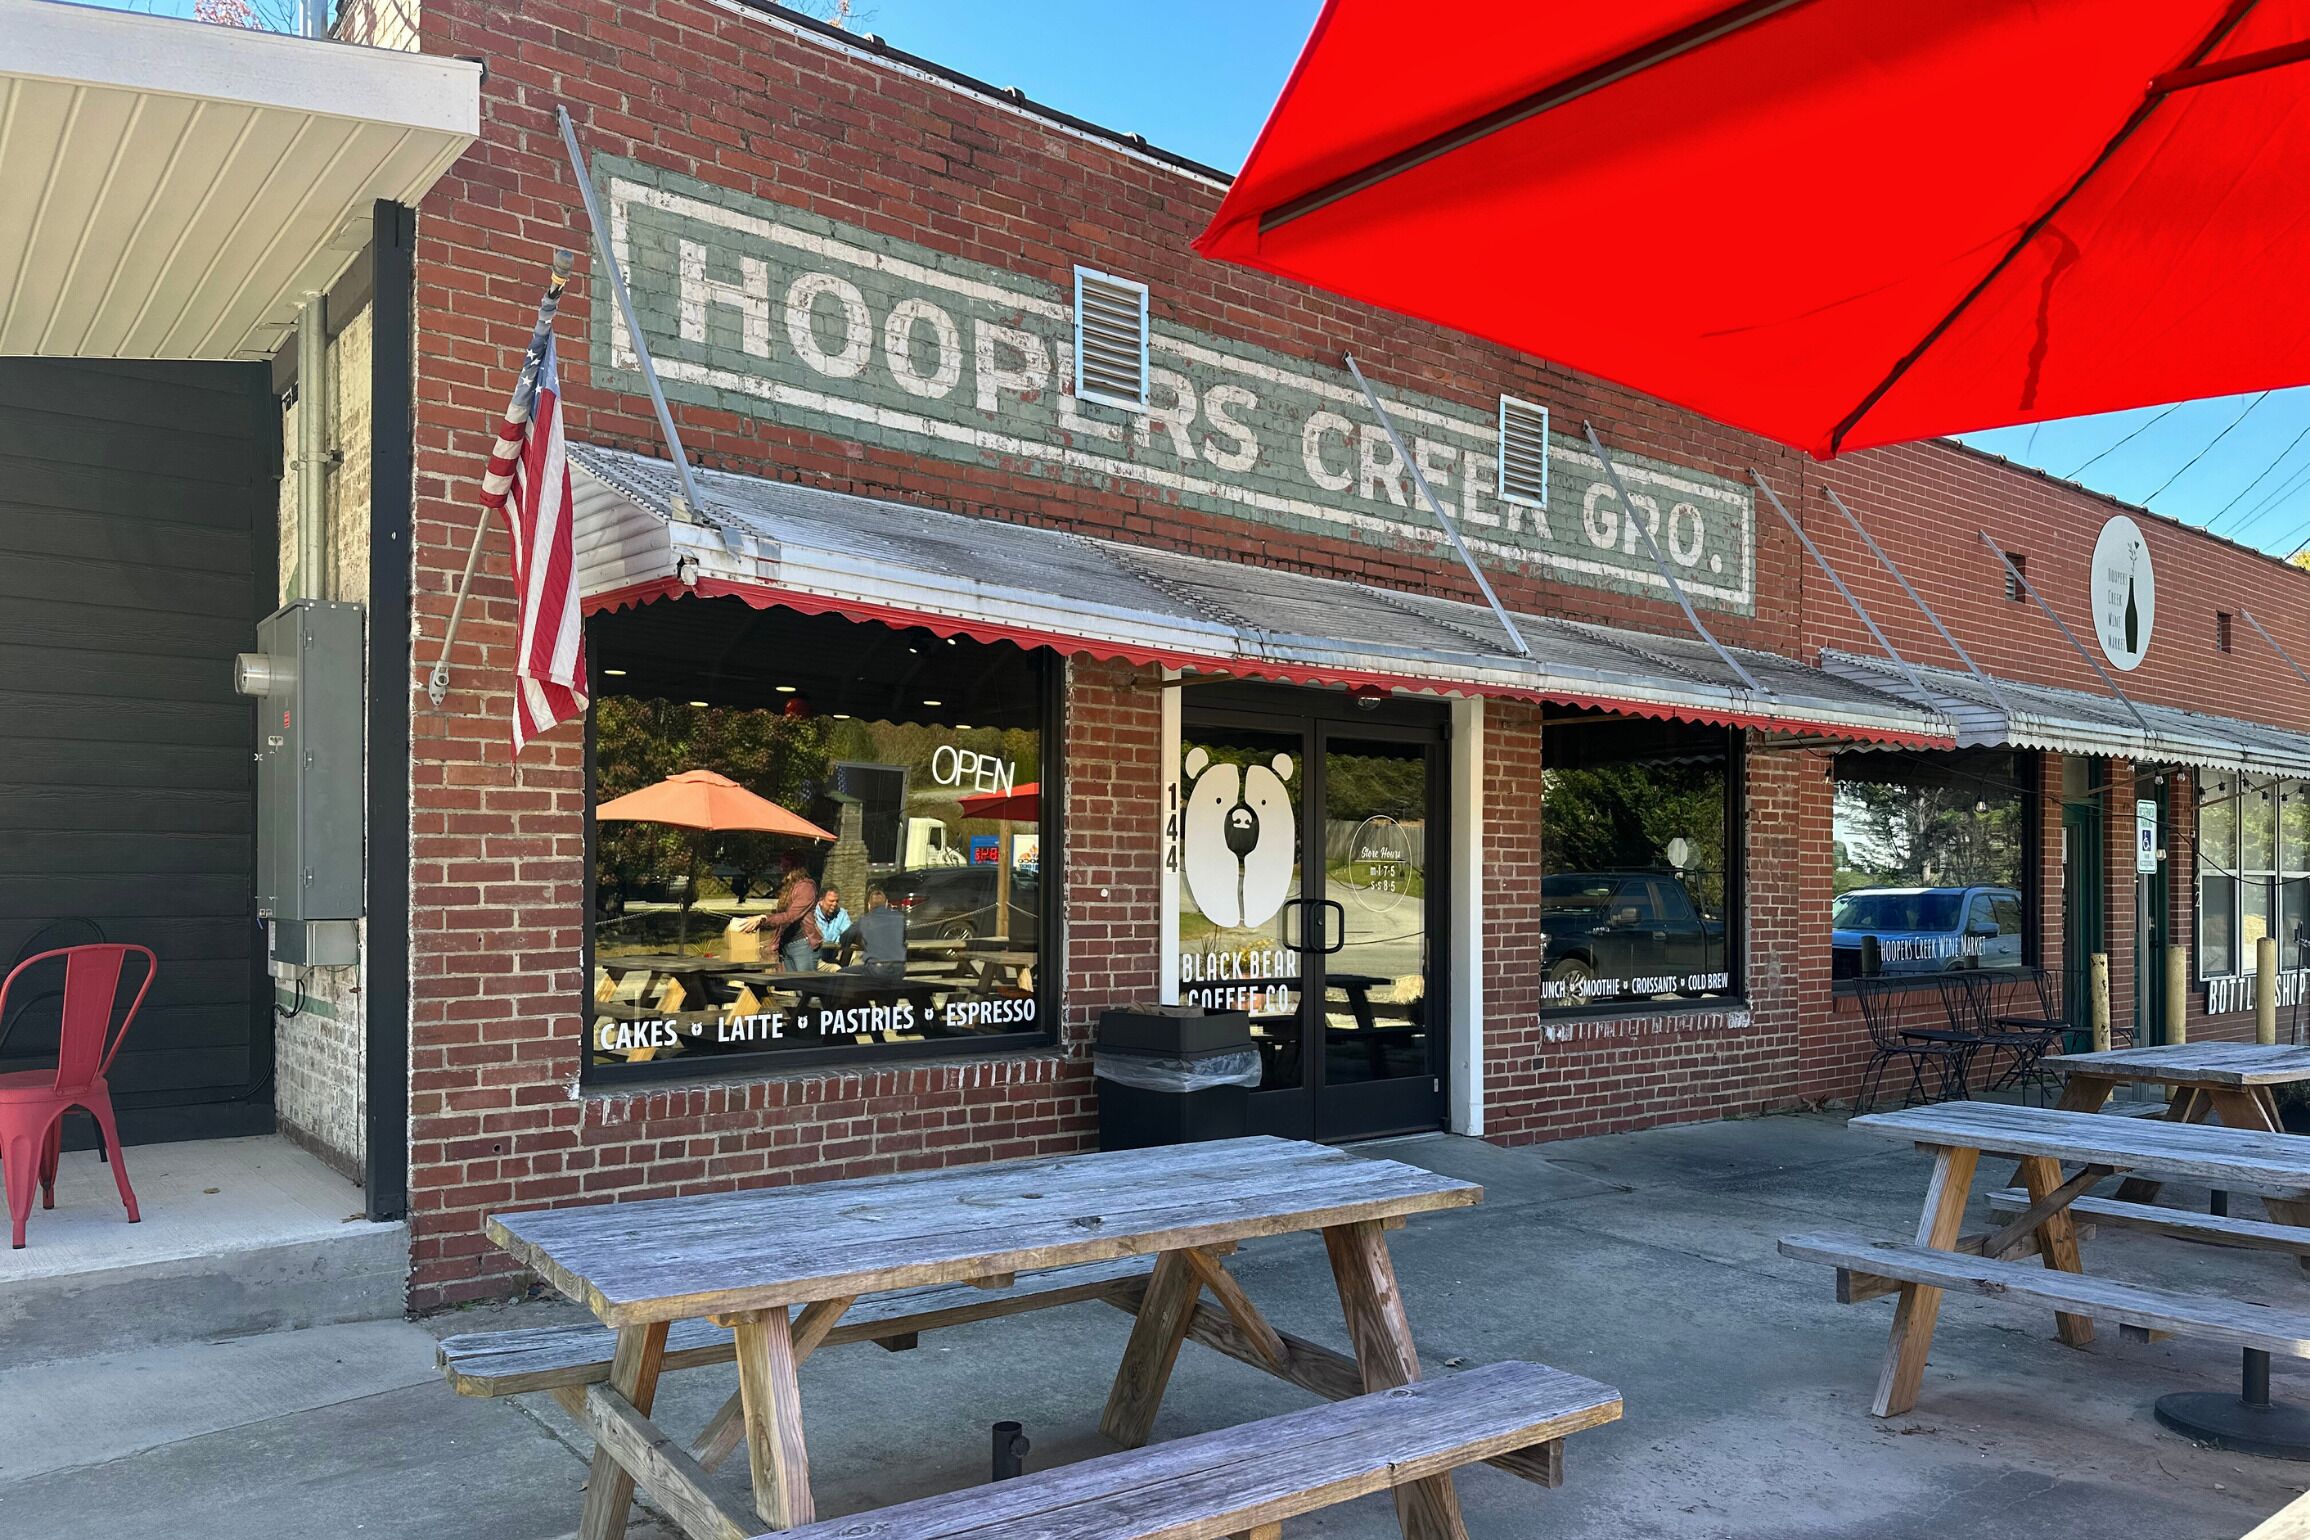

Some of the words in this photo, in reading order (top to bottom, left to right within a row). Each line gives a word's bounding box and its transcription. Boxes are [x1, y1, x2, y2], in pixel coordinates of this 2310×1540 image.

[1583, 482, 1723, 574] GRO.
[2108, 590, 2122, 607] CREEK
[932, 745, 1015, 797] OPEN
[1166, 783, 1178, 872] 144
[1361, 846, 1379, 859] Store
[1880, 939, 1913, 961] HOOPERS
[1915, 936, 1937, 959] CREEK
[1939, 935, 1959, 958] WINE
[1961, 934, 1986, 957] MARKET
[1182, 952, 1244, 983] BLACK
[1249, 949, 1297, 979] BEAR
[1188, 986, 1259, 1017] COFFEE
[1540, 981, 1566, 999] UNCH
[1578, 978, 1620, 997] SMOOTHIE
[1631, 976, 1677, 994] CROISSANTS
[1688, 973, 1706, 991] COLD
[1707, 972, 1729, 989] BREW
[2208, 977, 2257, 1015] BOTTL
[2274, 973, 2306, 1008] SHOP
[600, 1019, 678, 1051] CAKES
[718, 1013, 784, 1043] LATTE
[820, 1005, 915, 1035] PASTRIES
[946, 998, 1036, 1027] ESPRESSO
